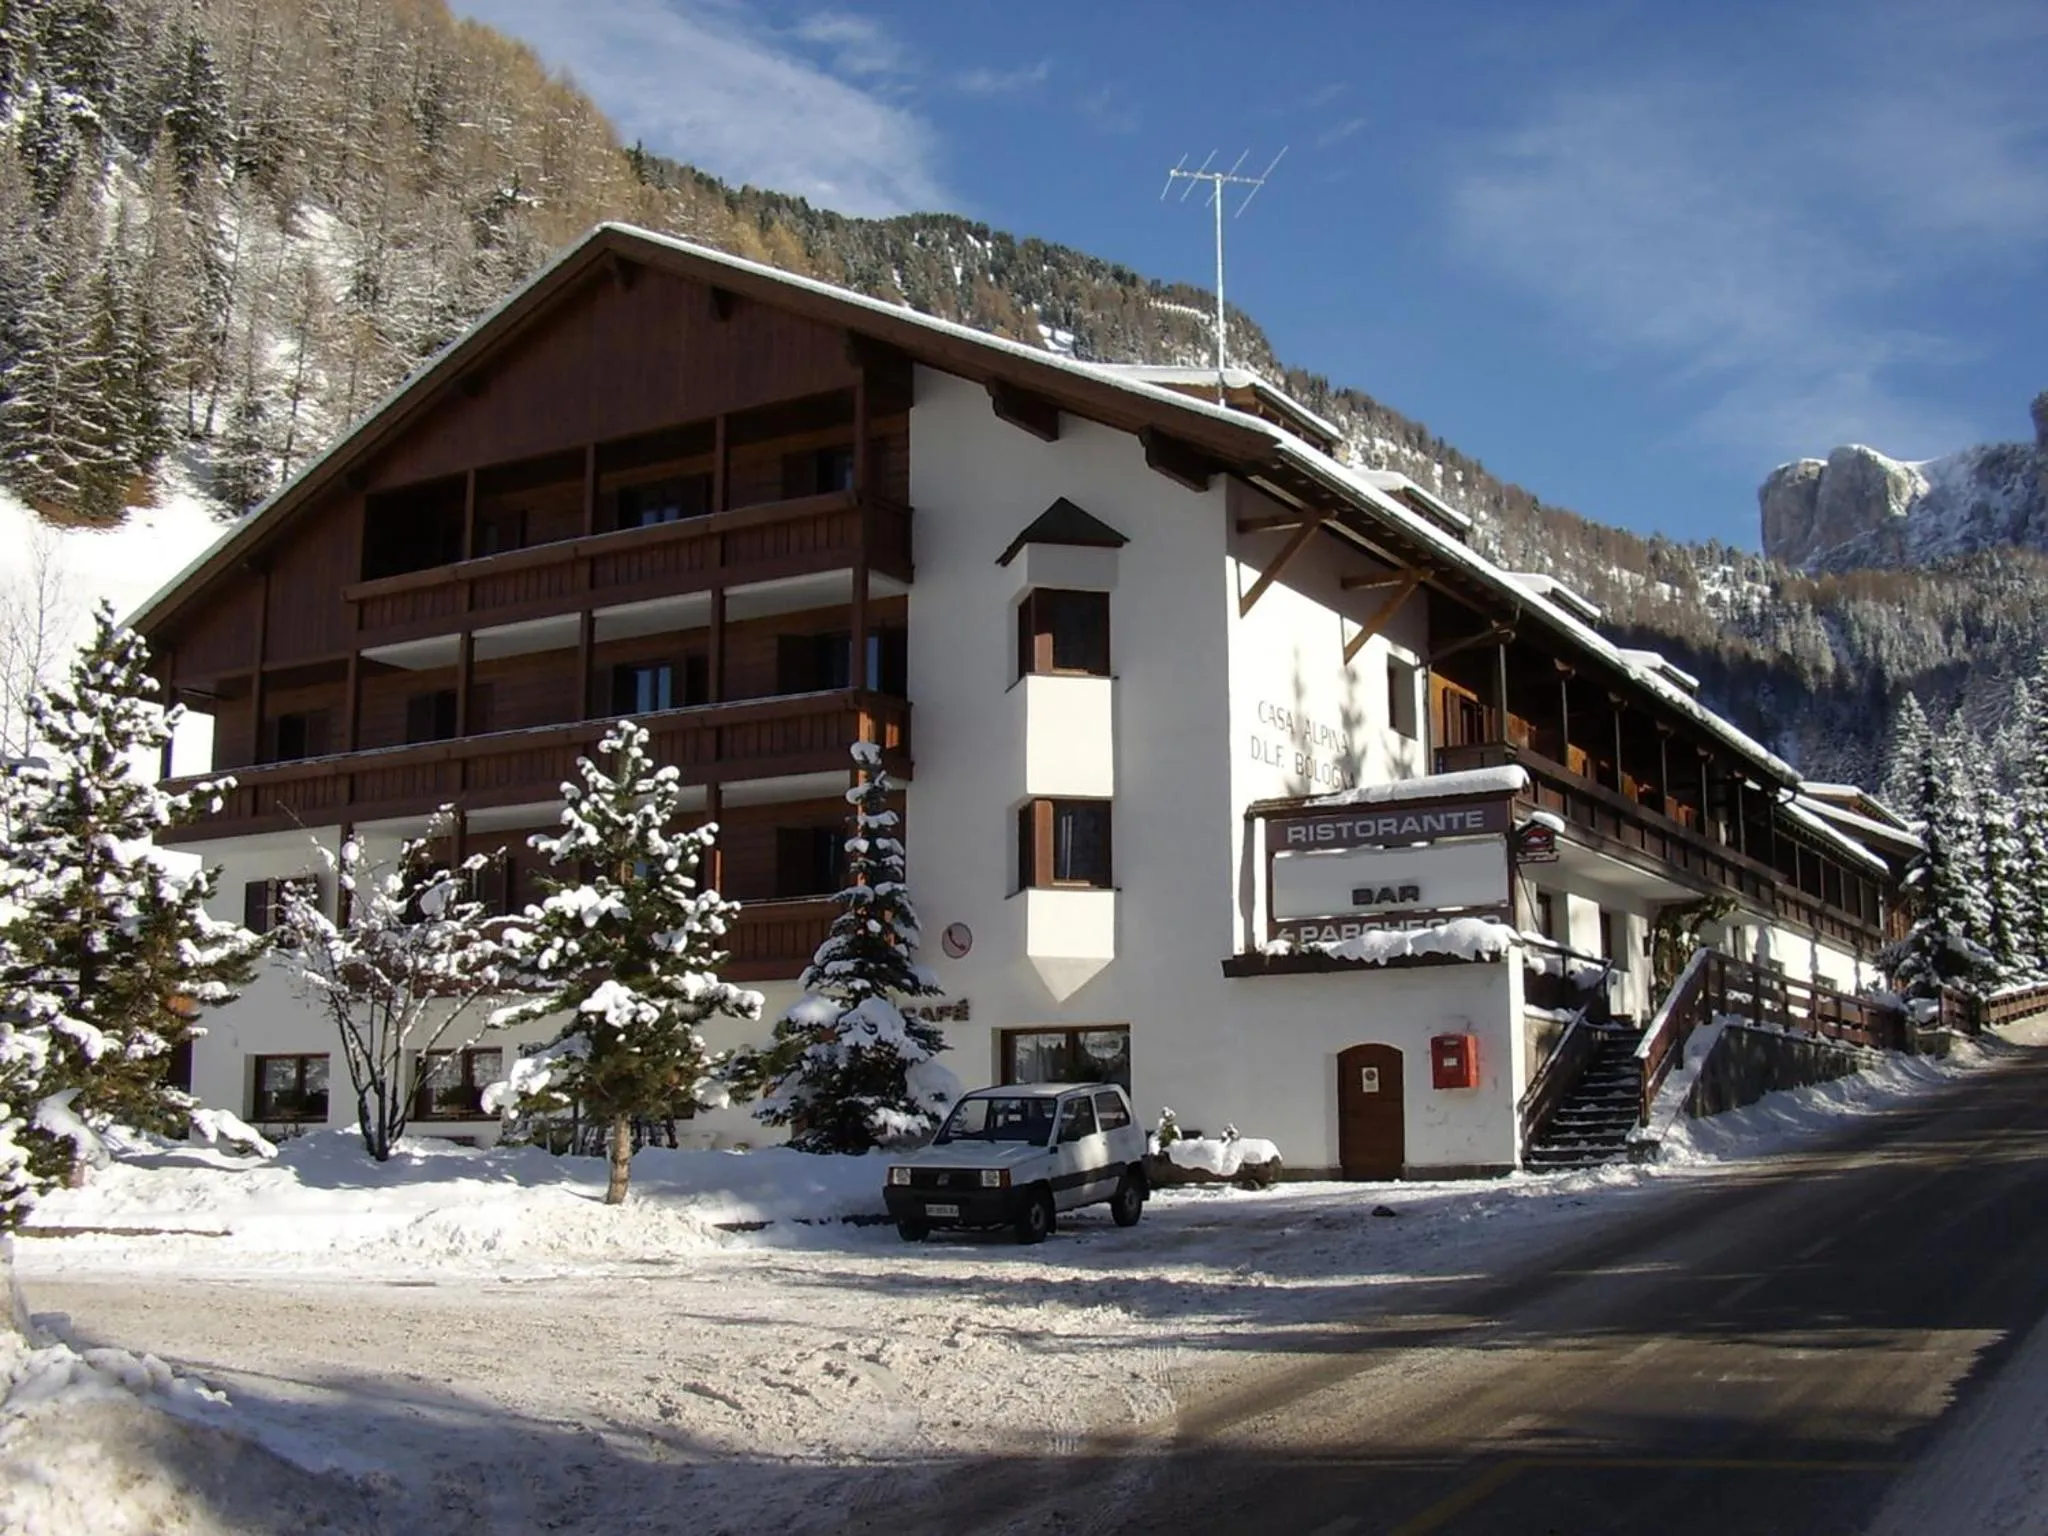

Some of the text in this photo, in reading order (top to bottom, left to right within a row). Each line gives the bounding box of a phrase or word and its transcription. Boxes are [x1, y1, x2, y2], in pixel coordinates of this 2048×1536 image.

[1258, 700, 1295, 735] CASA
[1286, 810, 1484, 843] RISTORANTE
[1351, 884, 1420, 906] BAR
